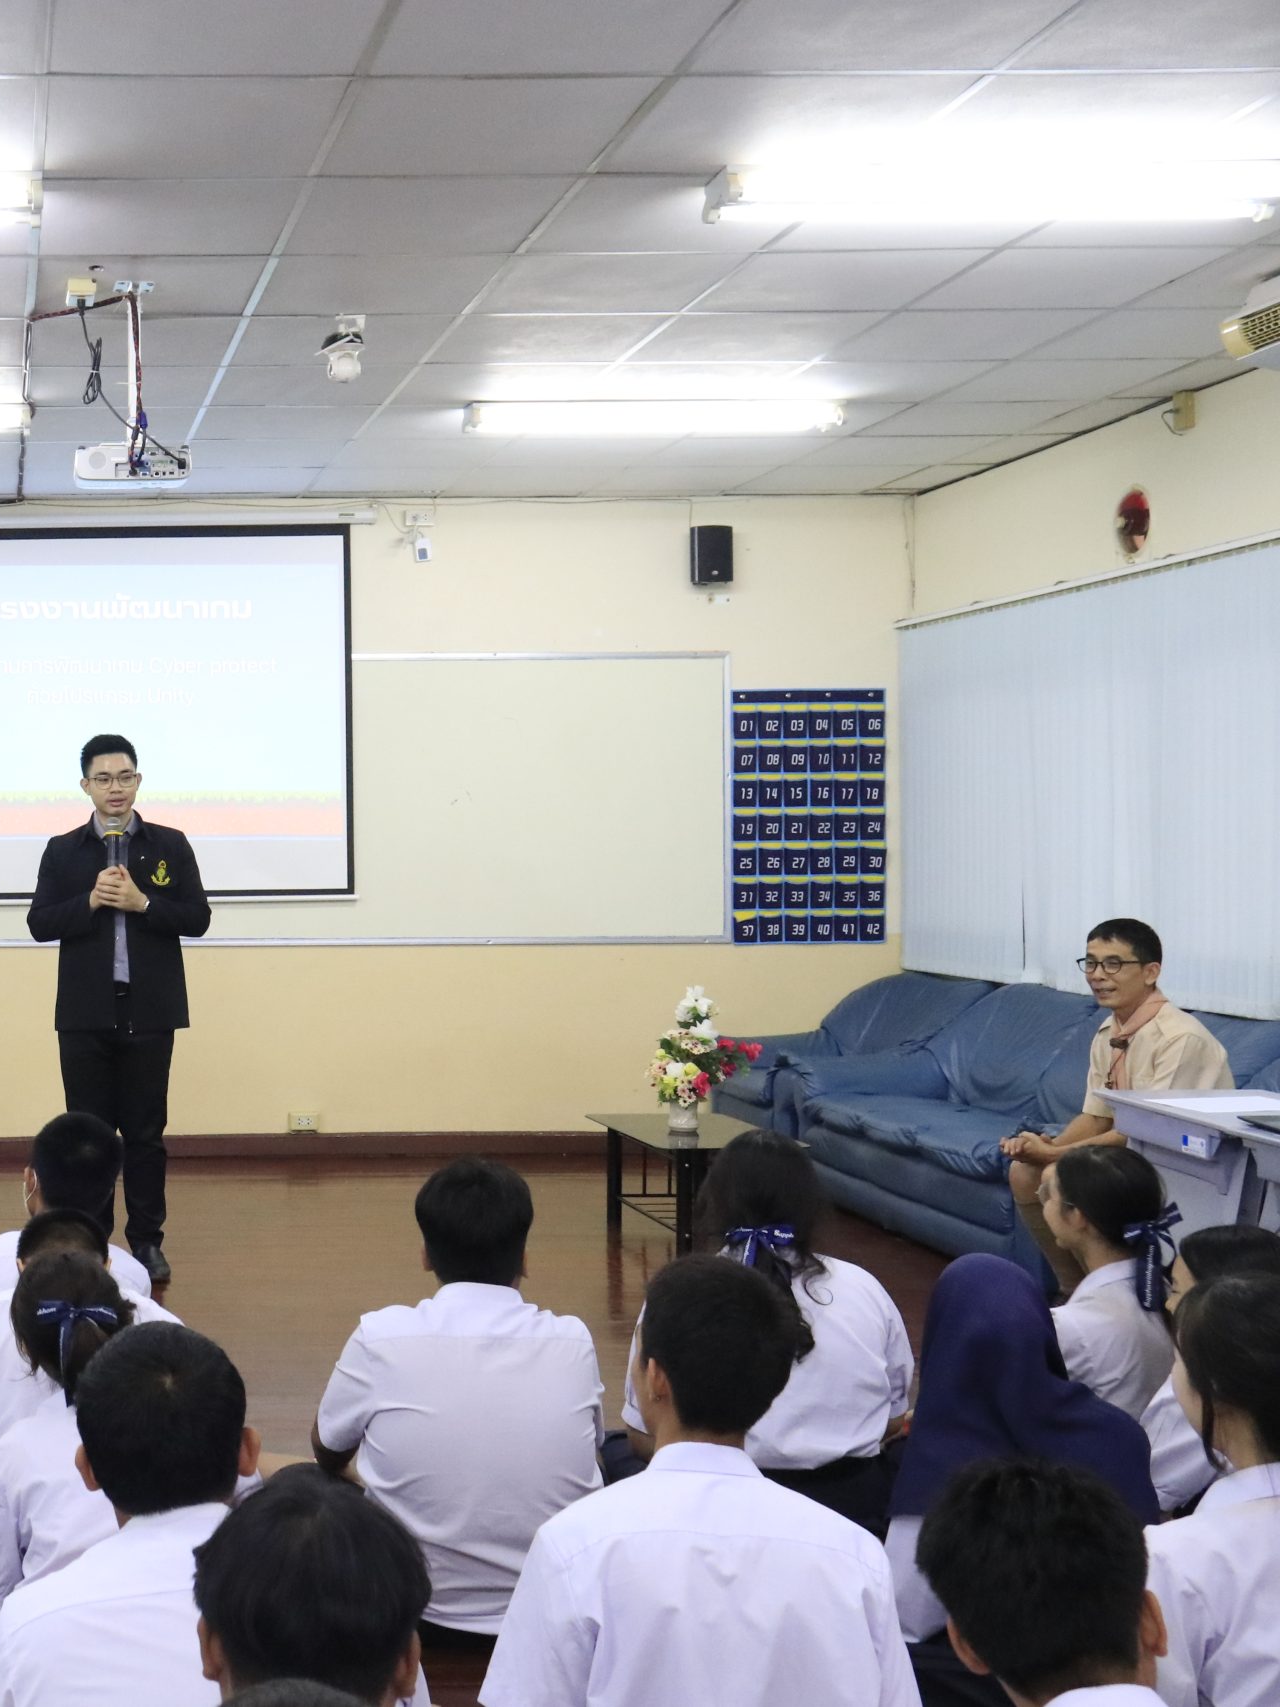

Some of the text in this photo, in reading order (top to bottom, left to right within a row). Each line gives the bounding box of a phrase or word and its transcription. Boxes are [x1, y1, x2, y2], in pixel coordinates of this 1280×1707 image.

[149, 656, 203, 678] Cyber
[210, 656, 278, 678] protect
[147, 687, 195, 709] Unity
[740, 719, 881, 731] 01 02 03 04 05 06
[741, 753, 881, 766] 07 08 09 10 11 12
[742, 787, 879, 799] 13 14 15 16 17 18
[741, 822, 880, 834] 19 20 21 22 23 24
[740, 856, 882, 868] 25 26 27 28 29 30
[740, 891, 880, 902] 31 32 33 34 35 36
[743, 924, 879, 936] 37 38 39 40 41 42
